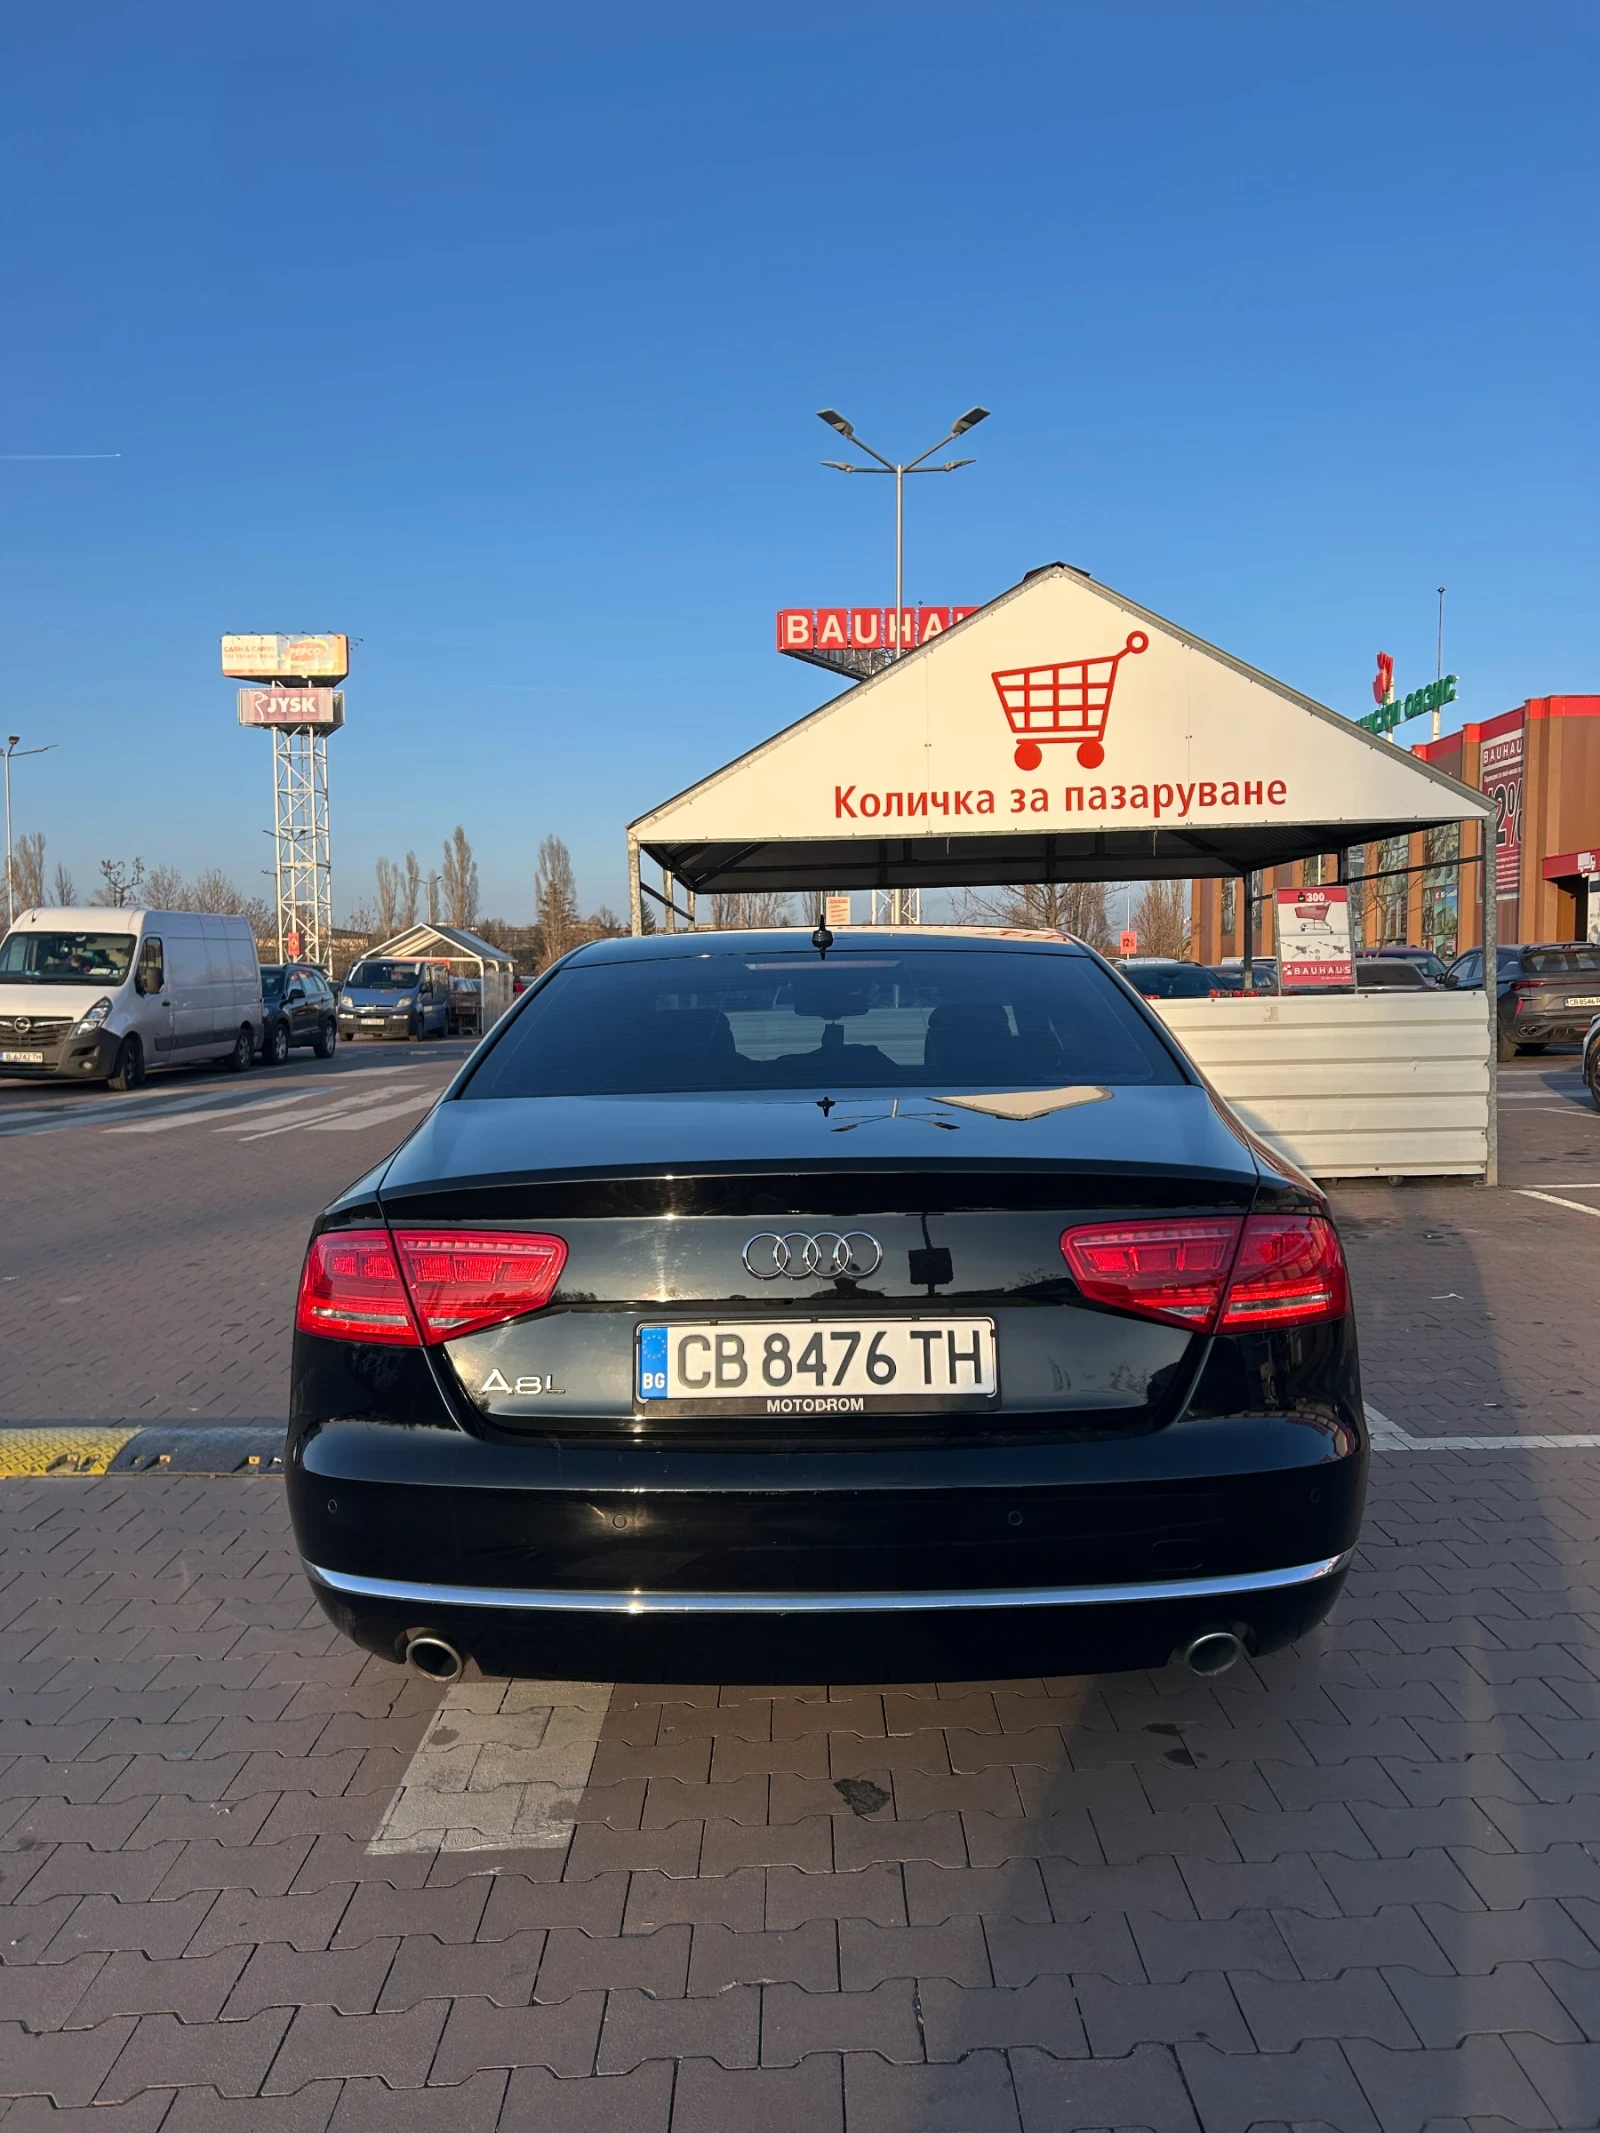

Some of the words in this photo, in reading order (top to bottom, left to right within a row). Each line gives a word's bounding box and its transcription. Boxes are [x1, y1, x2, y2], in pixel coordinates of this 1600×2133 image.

[267, 697, 317, 713] JYSK
[835, 786, 995, 818] Количка
[1010, 788, 1049, 813] за
[1065, 779, 1287, 818] пазаруване
[1306, 892, 1325, 902] 300
[1294, 965, 1352, 975] BAUHAUS
[643, 1372, 666, 1389] BG
[678, 1333, 748, 1389] CB
[762, 1330, 897, 1387] 8476
[910, 1329, 982, 1385] TH
[480, 1368, 565, 1395] A8L
[766, 1398, 864, 1413] MOTODROM
